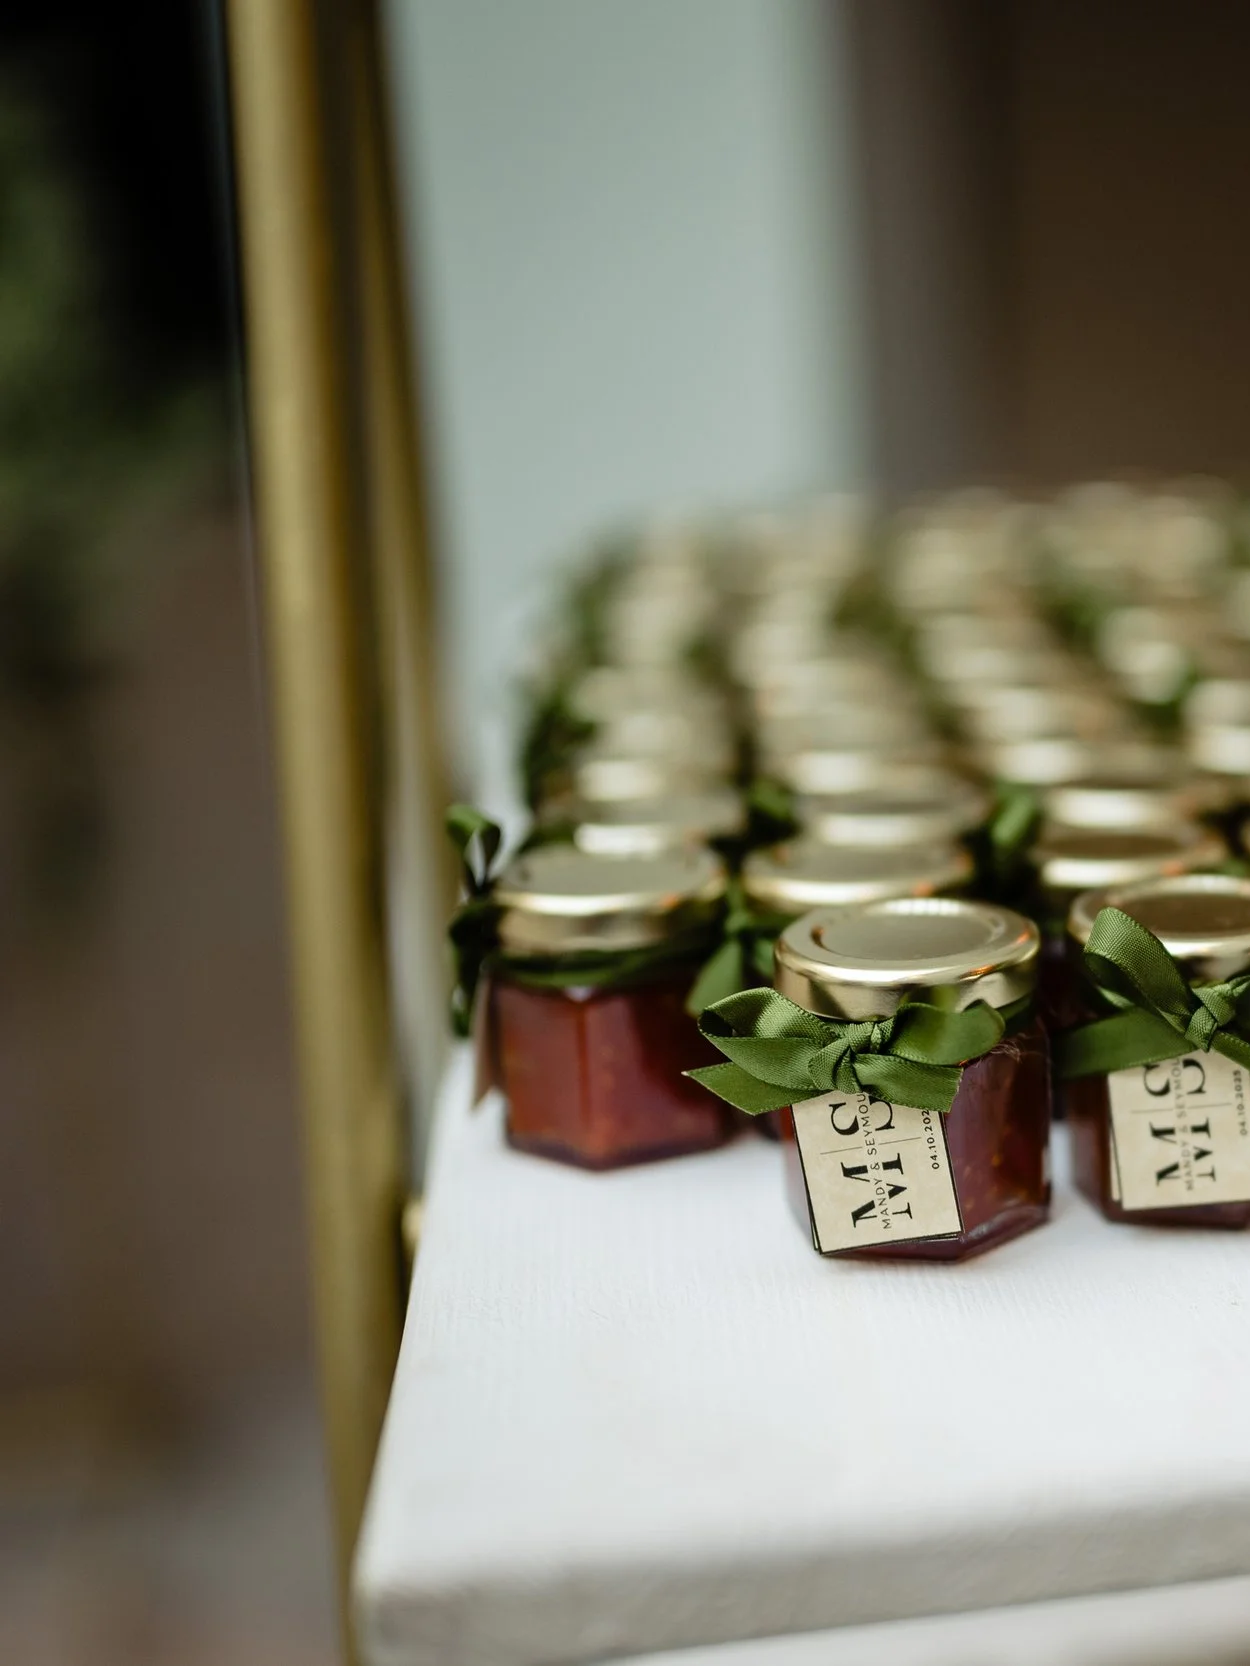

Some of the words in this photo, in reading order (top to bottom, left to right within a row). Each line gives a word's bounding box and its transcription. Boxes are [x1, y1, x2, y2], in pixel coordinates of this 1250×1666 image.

[1142, 1057, 1207, 1097] S
[1232, 1069, 1248, 1137] 04.10.2025
[828, 1095, 896, 1136] S
[856, 1093, 878, 1156] SEYMOU
[920, 1108, 940, 1170] 04.10.202
[1177, 1123, 1189, 1134] &
[870, 1161, 881, 1171] &
[1149, 1116, 1217, 1187] M
[1180, 1140, 1195, 1192] MANDY
[840, 1152, 913, 1228] M
[874, 1177, 893, 1230] MANDY
